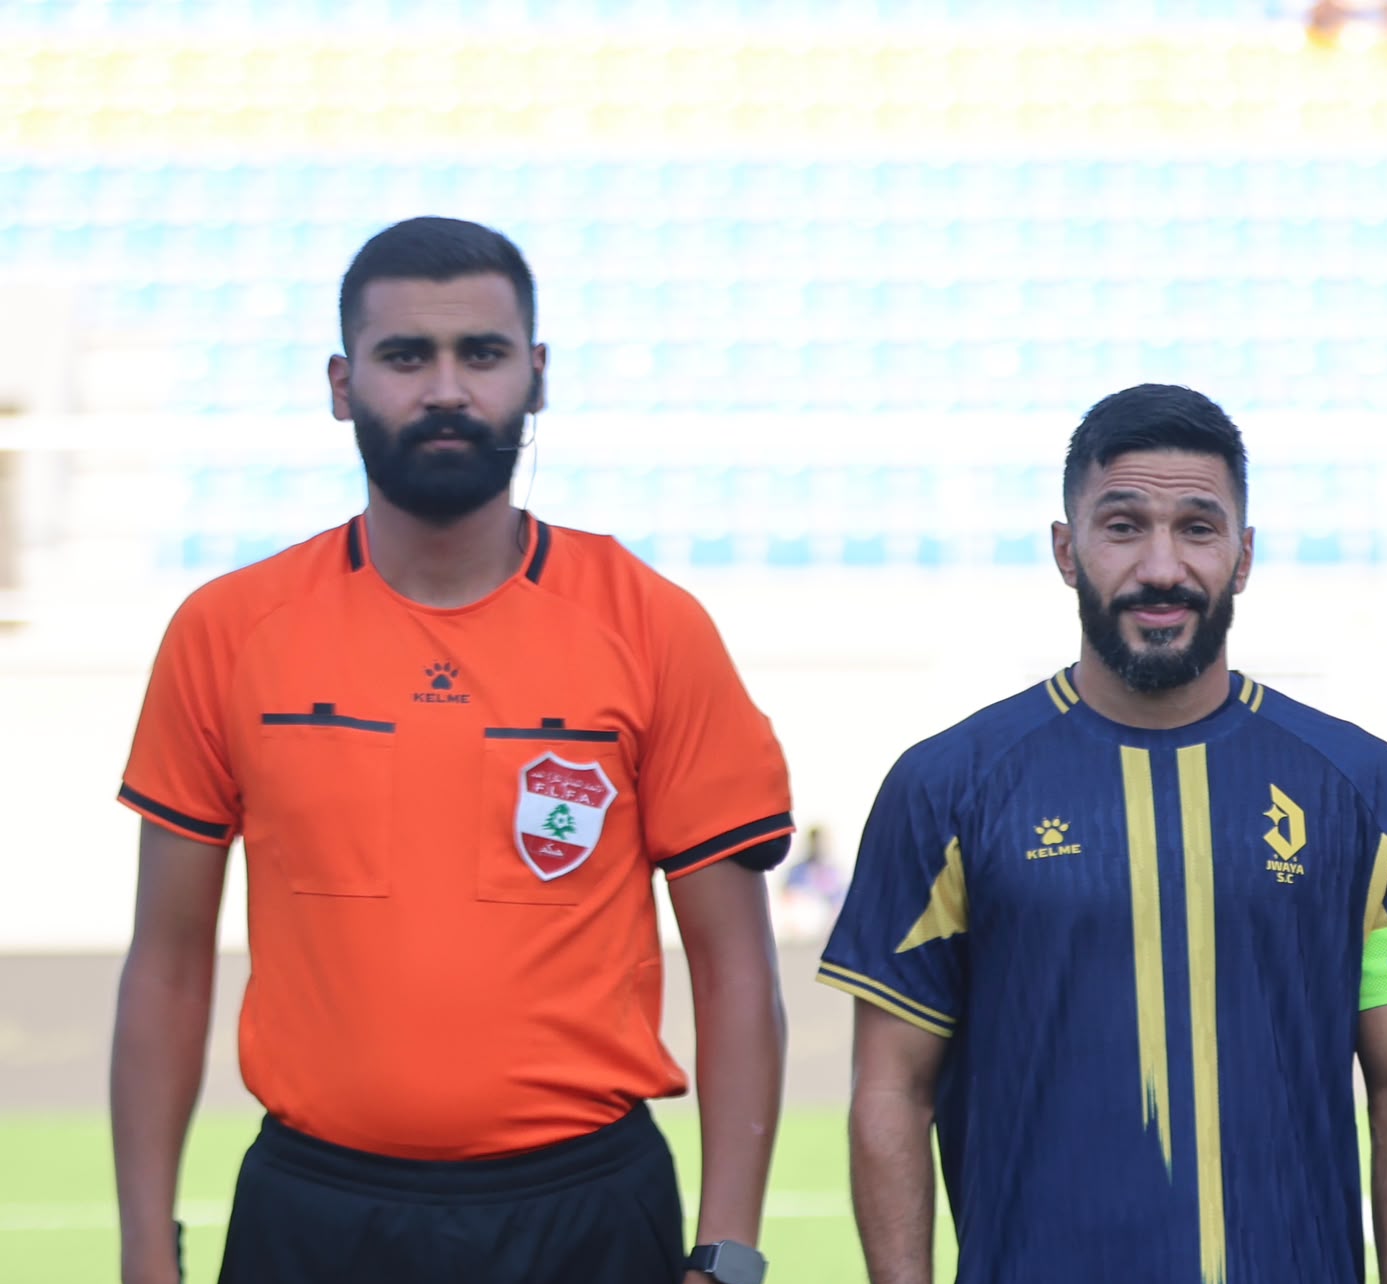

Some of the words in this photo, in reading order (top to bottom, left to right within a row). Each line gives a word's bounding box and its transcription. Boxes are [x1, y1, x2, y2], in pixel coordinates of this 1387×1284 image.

[413, 693, 470, 704] KELME
[1026, 844, 1082, 860] KELME
[1265, 860, 1305, 876] JWAYA
